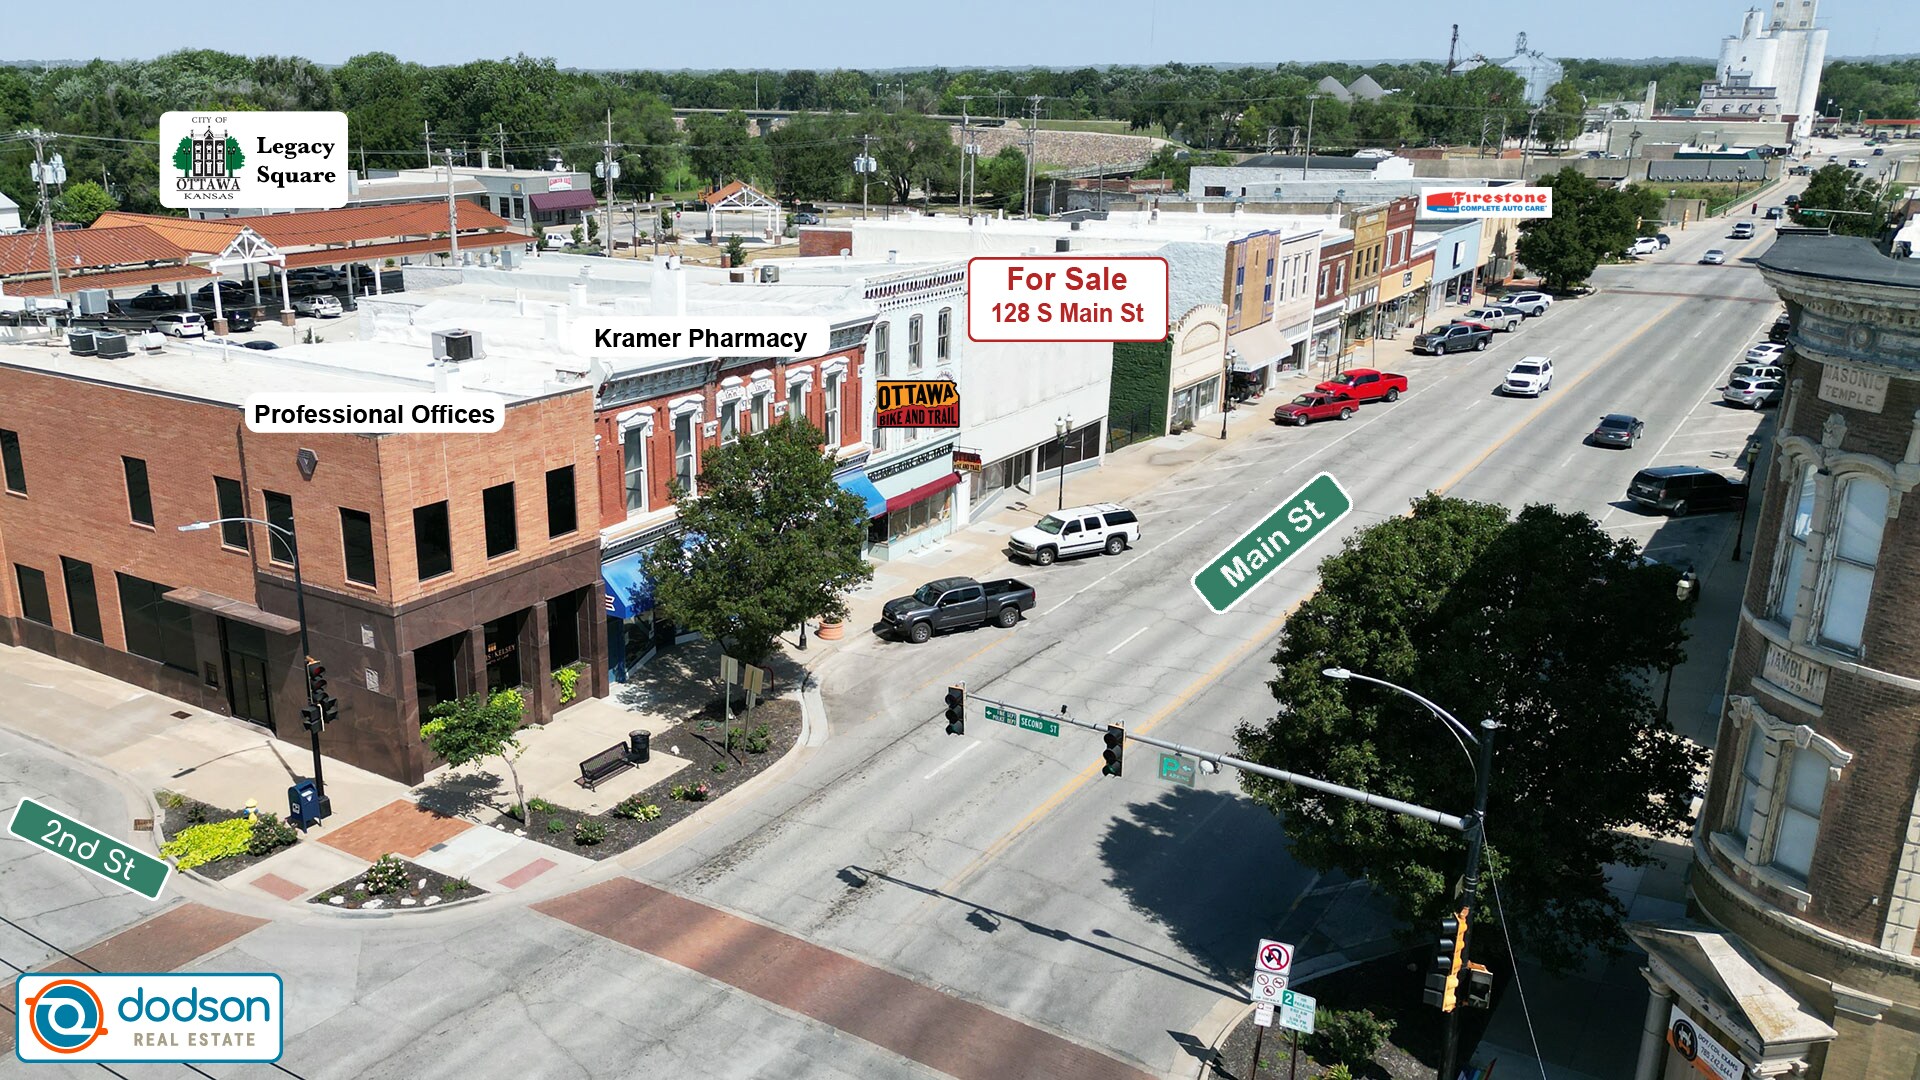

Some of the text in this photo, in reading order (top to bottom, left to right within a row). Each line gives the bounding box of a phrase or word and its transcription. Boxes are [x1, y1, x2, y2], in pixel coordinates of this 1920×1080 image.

[1823, 364, 1885, 391] MASONIC
[1767, 646, 1824, 689] HAMBLIN
[1021, 717, 1058, 734] SECOND ST
[1284, 993, 1293, 1005] 2
[1720, 1052, 1739, 1072] EXAMS
